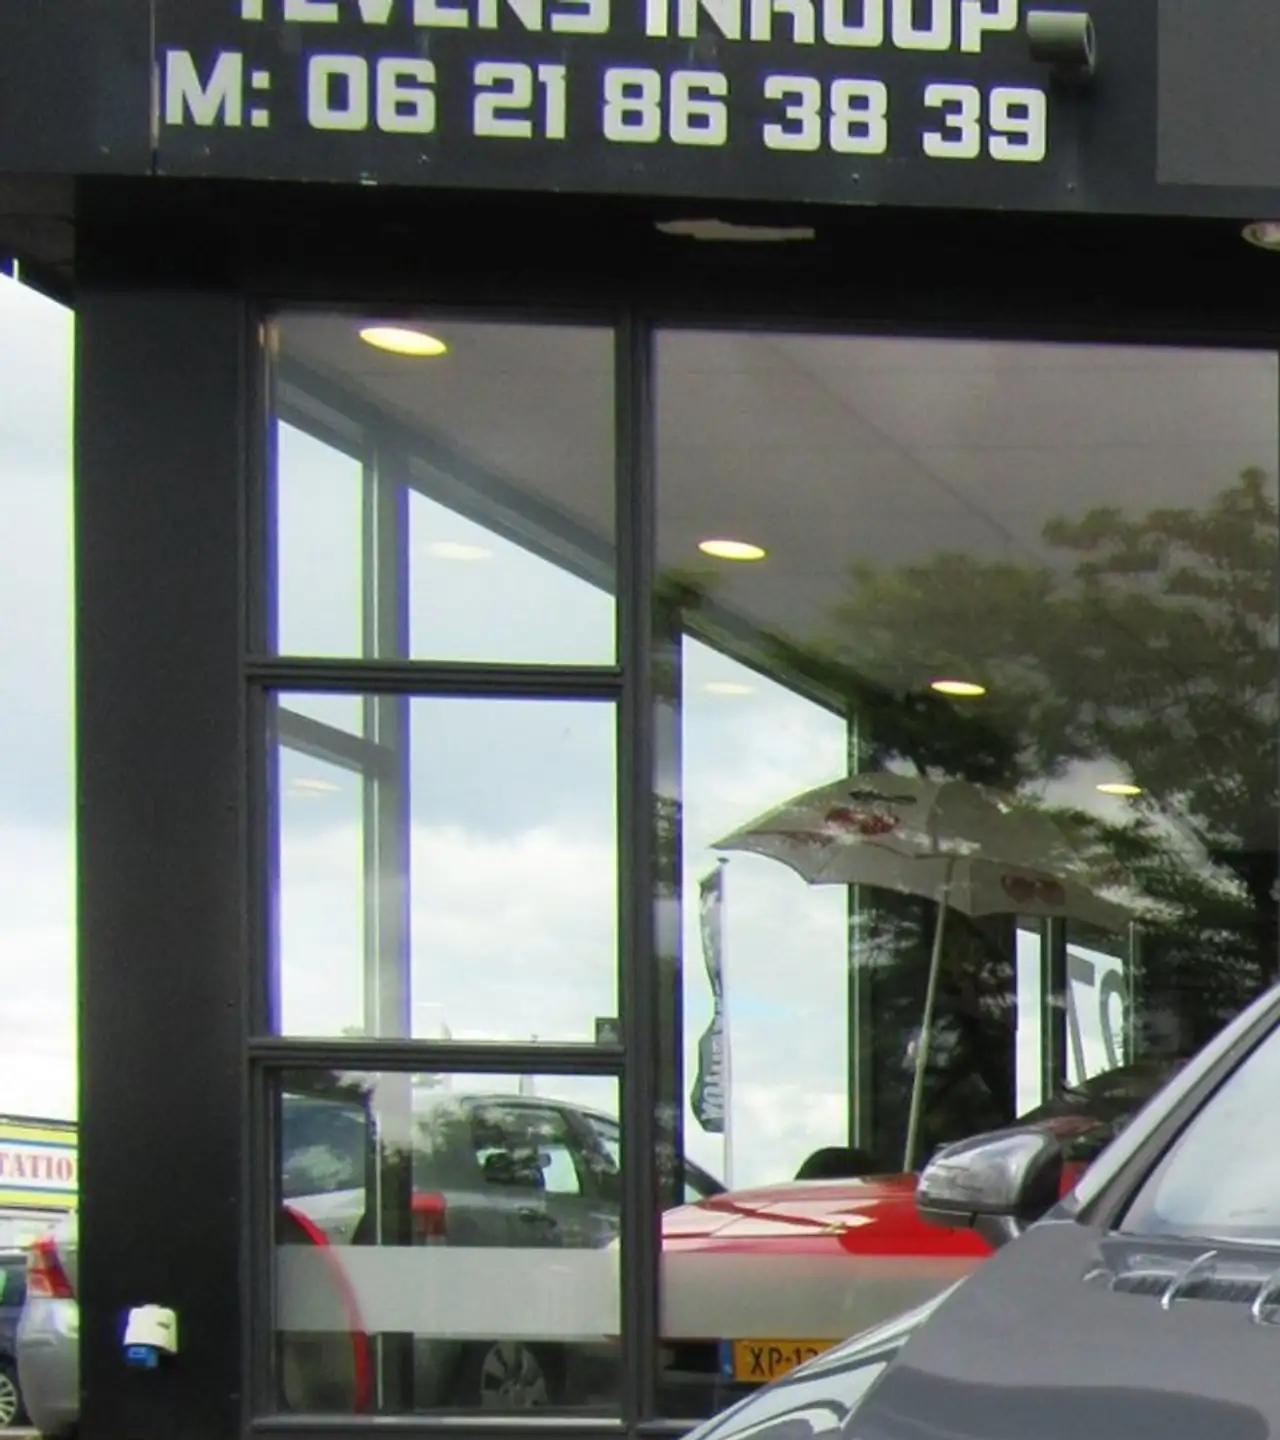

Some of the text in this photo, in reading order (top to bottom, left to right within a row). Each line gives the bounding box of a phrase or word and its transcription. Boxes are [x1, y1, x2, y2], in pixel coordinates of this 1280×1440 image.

[166, 50, 1047, 162] M: 06 21 86 38 39
